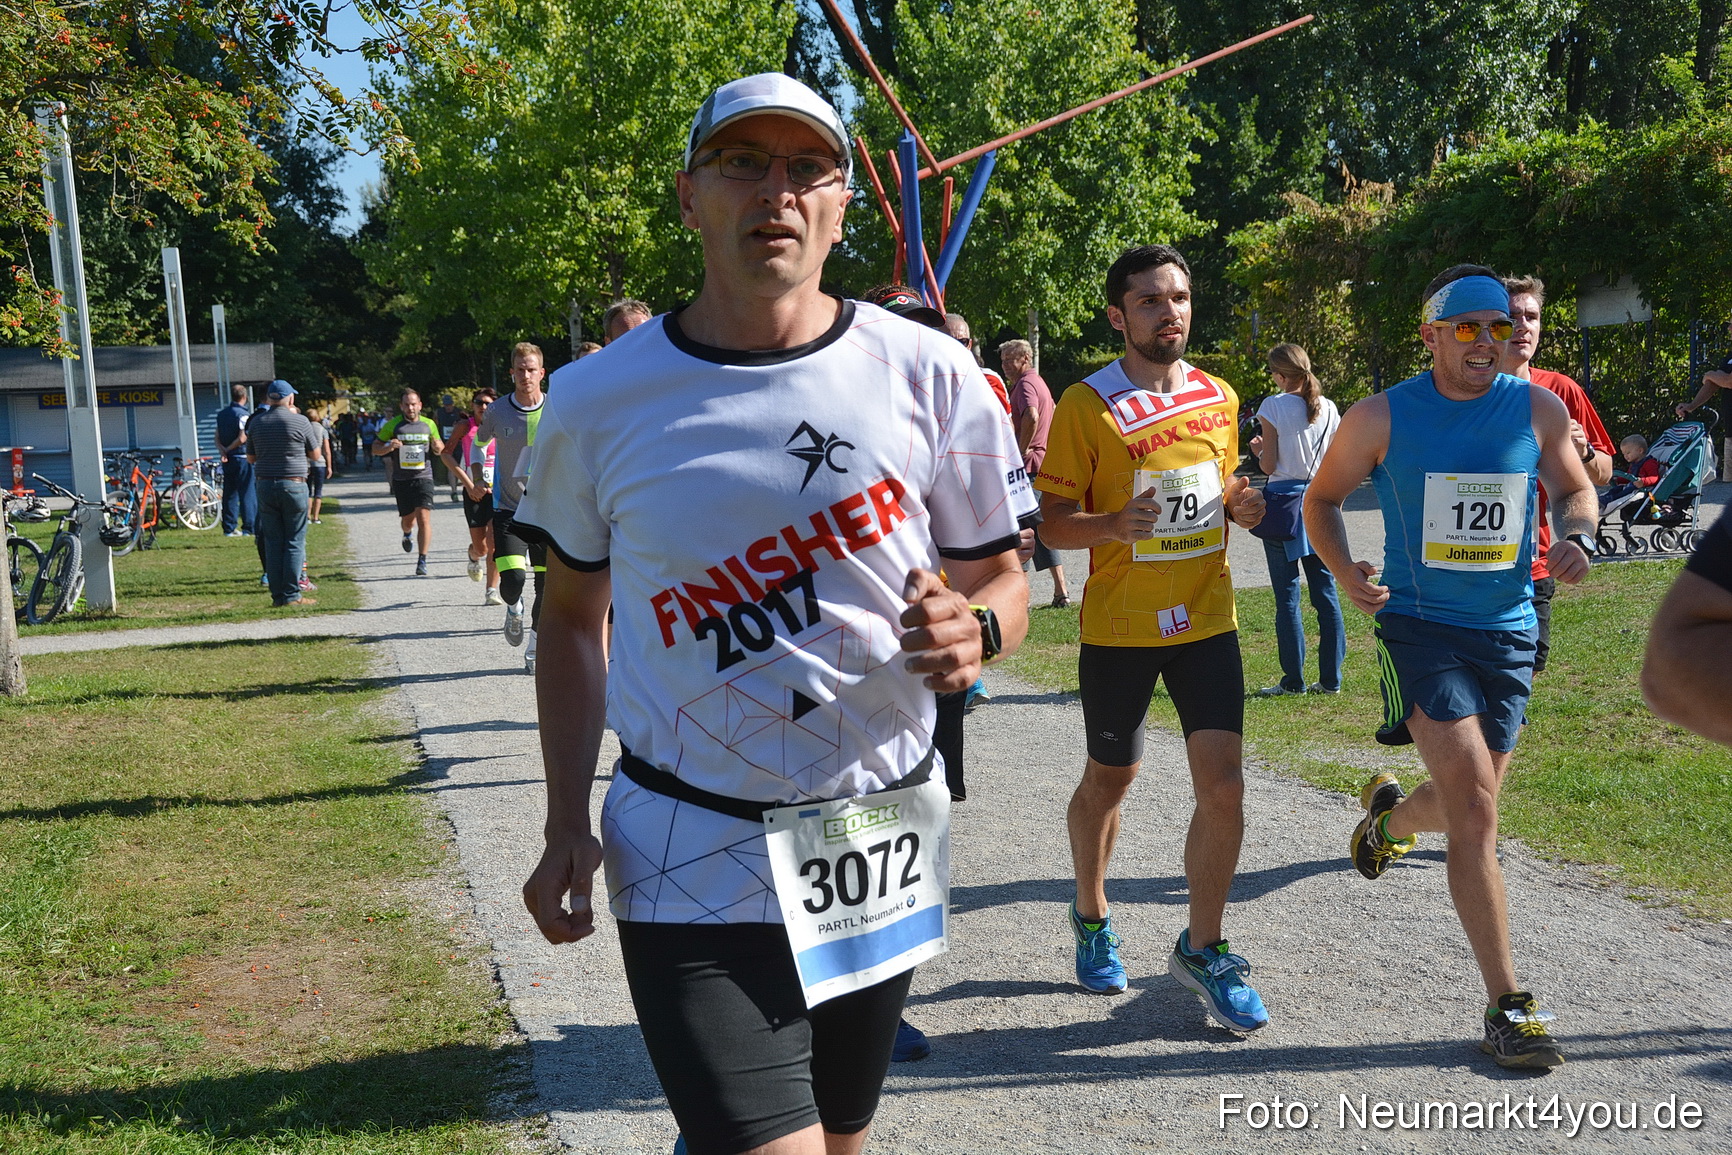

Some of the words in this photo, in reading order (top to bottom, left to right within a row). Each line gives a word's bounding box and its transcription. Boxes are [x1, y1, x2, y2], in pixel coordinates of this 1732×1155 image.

[1126, 426, 1183, 460] MAX
[1185, 411, 1231, 437] BÖGL
[405, 451, 420, 459] 282
[1162, 473, 1199, 489] BOCK
[1457, 483, 1503, 494] BOCK
[1166, 493, 1198, 523] 79
[1451, 501, 1506, 531] 120
[1177, 523, 1202, 533] Neumarkt
[1161, 536, 1205, 551] Mathias
[1446, 547, 1503, 560] Johannes
[650, 477, 907, 648] FINISHER
[694, 565, 822, 673] 2017
[823, 803, 900, 839] BOCK
[800, 832, 921, 914] 3072
[818, 917, 858, 934] PARTL
[860, 902, 904, 925] Neumarkt
